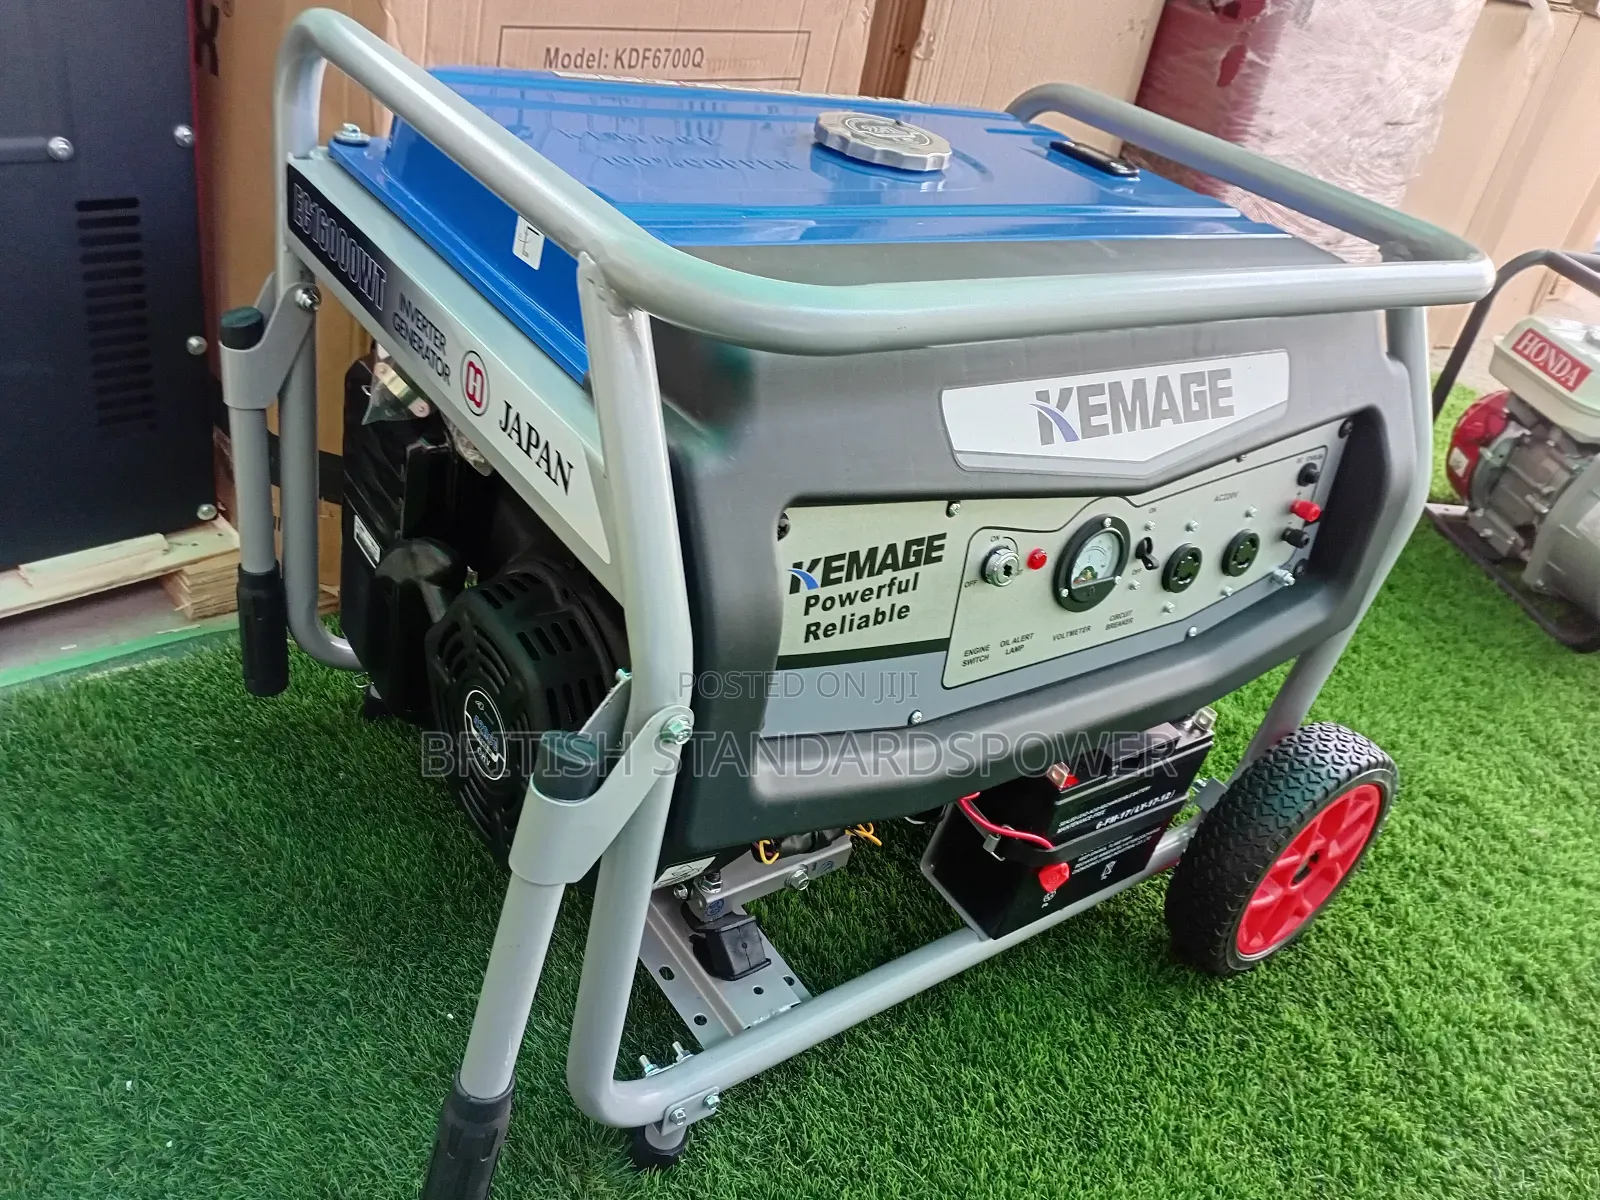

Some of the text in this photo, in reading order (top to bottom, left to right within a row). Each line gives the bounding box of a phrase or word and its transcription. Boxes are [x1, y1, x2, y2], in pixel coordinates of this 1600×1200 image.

[543, 47, 609, 69] Model:
[614, 47, 705, 69] KDF6700Q
[399, 292, 447, 355] INVERTER
[391, 312, 451, 387] GENERATOR
[1515, 332, 1581, 388] HONDA
[1029, 367, 1235, 447] KEMAGE
[499, 400, 574, 496] JAPAN
[990, 534, 1000, 542] ON
[787, 532, 948, 595] KEMAGE
[964, 579, 978, 588] OFF
[803, 571, 920, 616] Powerful
[803, 603, 911, 643] Reliable
[1105, 617, 1134, 631] BREAKER
[1108, 609, 1134, 622] CIRCUIT
[999, 632, 1035, 648] OIL ALERT
[1052, 625, 1092, 642] VOLTMETER
[963, 644, 991, 657] ENGINE
[1005, 644, 1025, 655] LAMP
[961, 654, 990, 667] SWITCH
